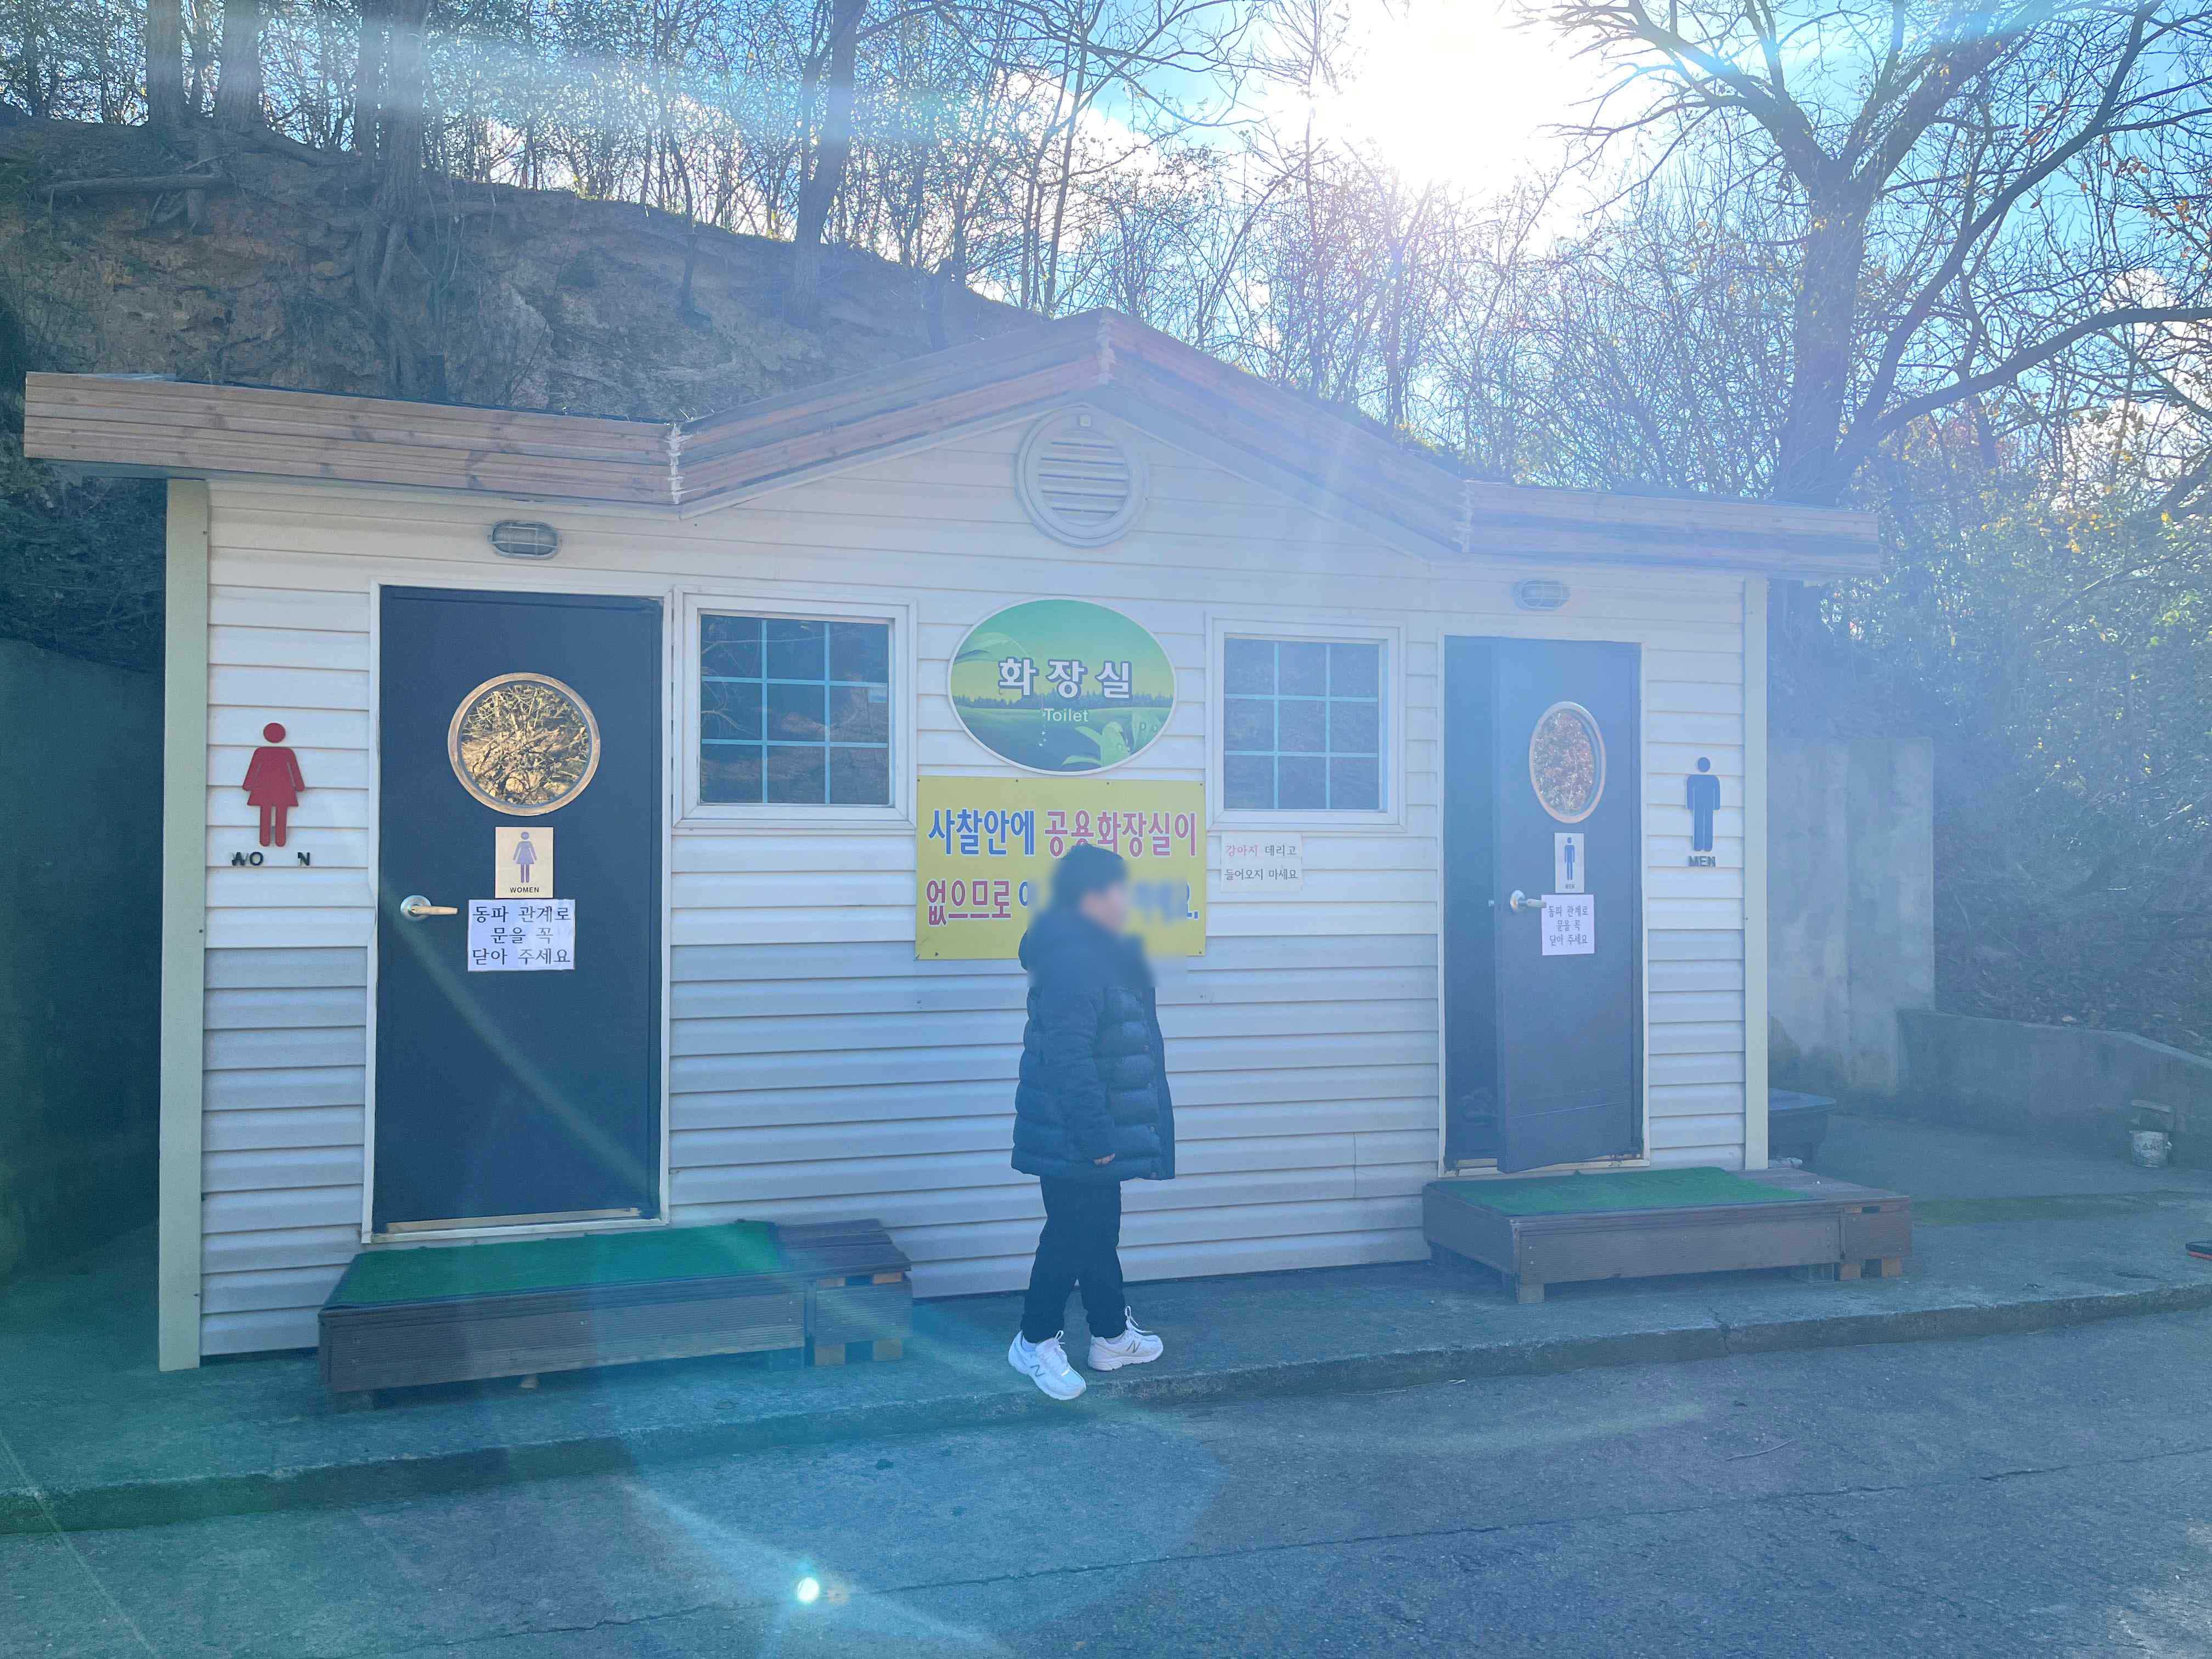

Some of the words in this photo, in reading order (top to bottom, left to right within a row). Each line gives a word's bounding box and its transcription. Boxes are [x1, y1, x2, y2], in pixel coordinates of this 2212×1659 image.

[1044, 708, 1089, 723] Toilet
[928, 809, 1035, 855] 사찰안에
[1226, 845, 1258, 857] 강아지
[1265, 845, 1297, 856] 데리고
[1688, 856, 1716, 867] MEN
[1224, 868, 1263, 881] 들어오지
[1268, 868, 1299, 881] 마세요
[926, 880, 1012, 926] 없으므로
[472, 905, 509, 923] 동파
[518, 905, 572, 923] 관계로
[490, 927, 526, 944] 문을
[535, 927, 554, 944] 꼭
[1567, 934, 1589, 946] 주세요
[472, 947, 508, 966] 닫아
[517, 947, 571, 965] 주세요
